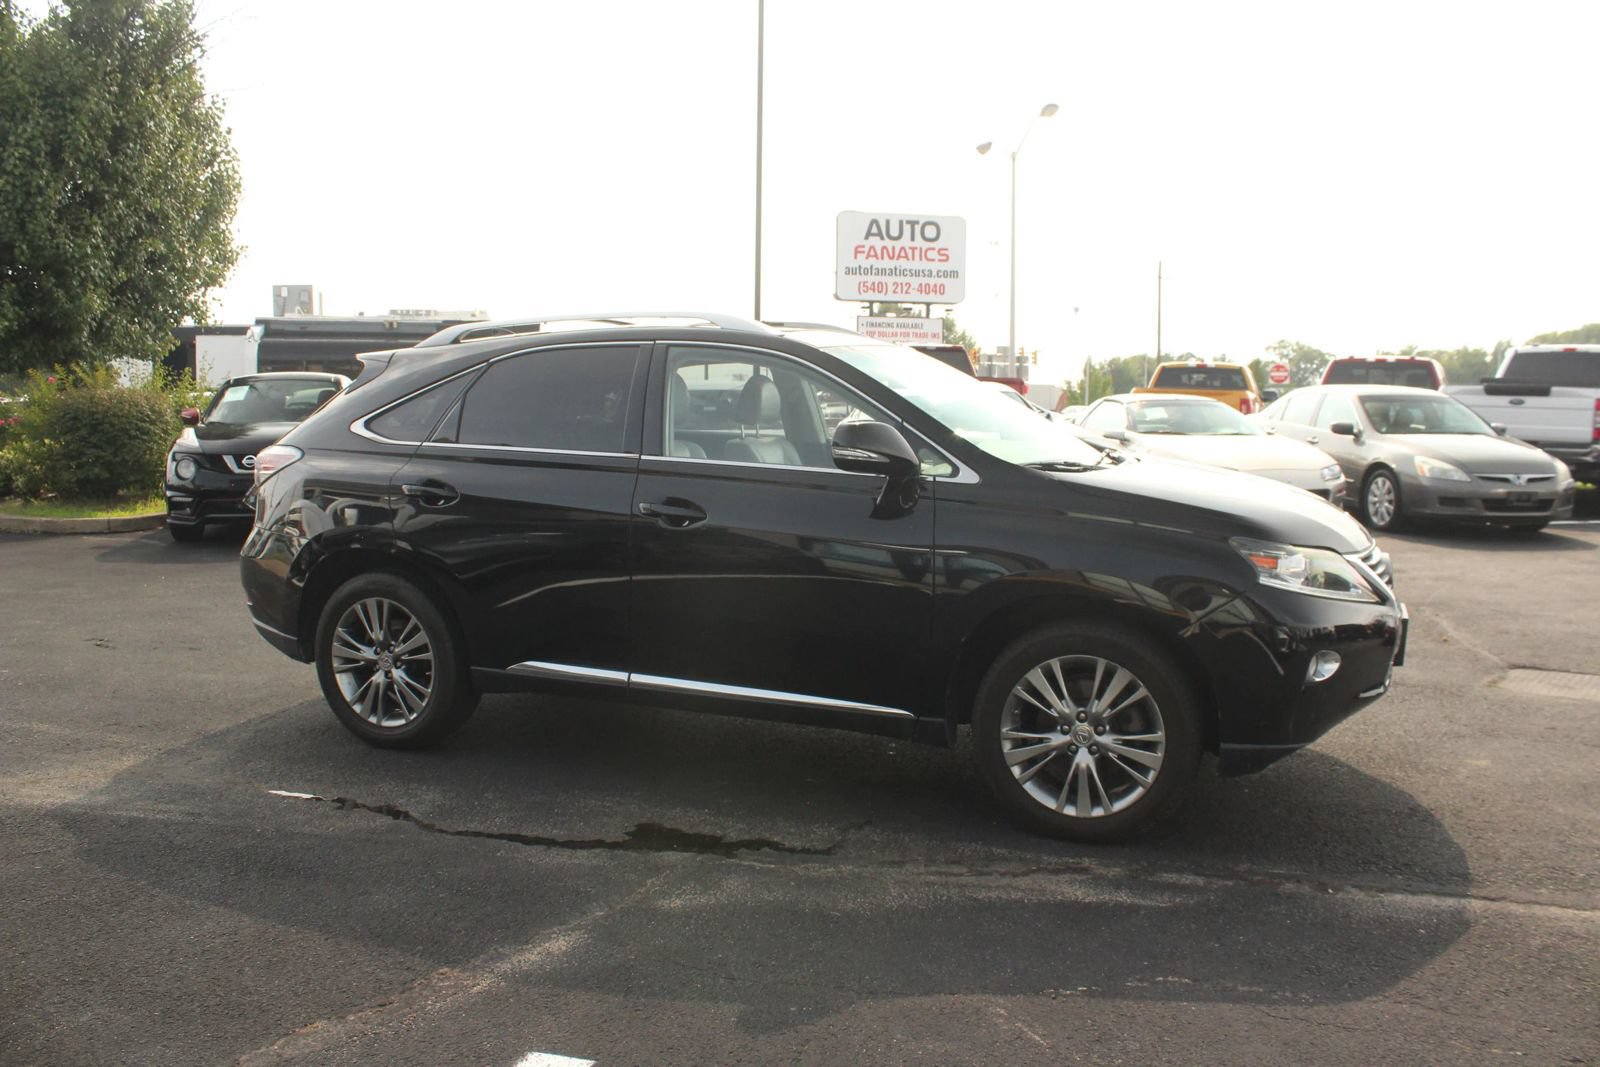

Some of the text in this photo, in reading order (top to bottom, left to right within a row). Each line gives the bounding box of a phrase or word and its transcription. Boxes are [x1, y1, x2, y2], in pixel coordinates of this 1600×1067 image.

[864, 218, 941, 242] AUTO
[854, 244, 950, 262] FANATICS
[844, 264, 959, 279] autofanaticsusa.com
[858, 281, 946, 295] (540) 212-4040
[866, 321, 894, 329] FINANCING
[878, 330, 897, 338] DOLLAR
